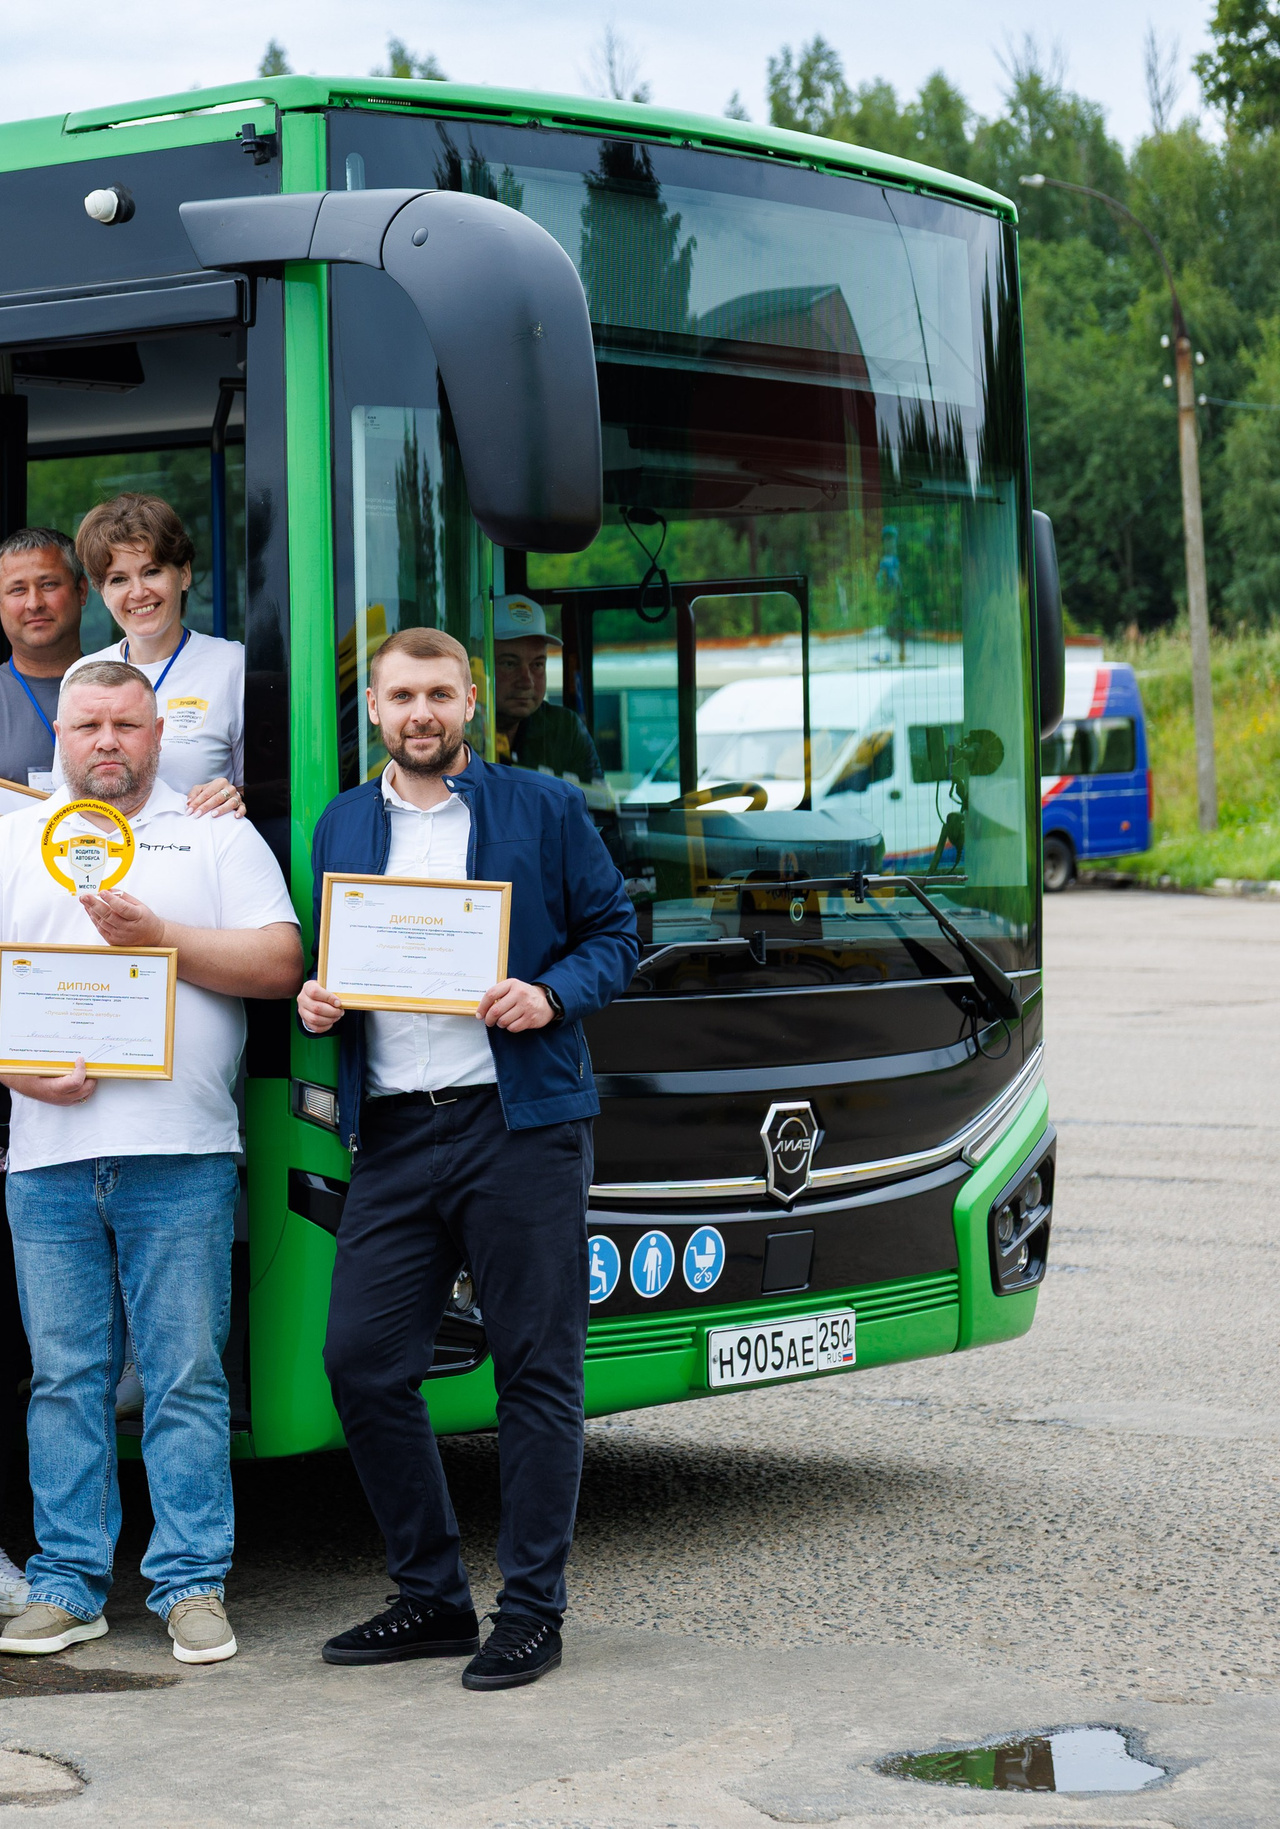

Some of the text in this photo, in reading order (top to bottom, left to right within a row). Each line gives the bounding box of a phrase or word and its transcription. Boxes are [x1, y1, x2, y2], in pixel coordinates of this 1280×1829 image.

[44, 803, 131, 847] КОНКУРС ПРОФЕССИОНАЛЬНОГО МАСТЕРСТВА
[140, 843, 191, 851] ЯТК-2
[390, 914, 443, 925] ДИПЛОМ
[57, 981, 110, 991] ДИПЛОМ
[720, 1319, 850, 1379] Н905АЕ 250
[827, 1352, 842, 1364] RUS
